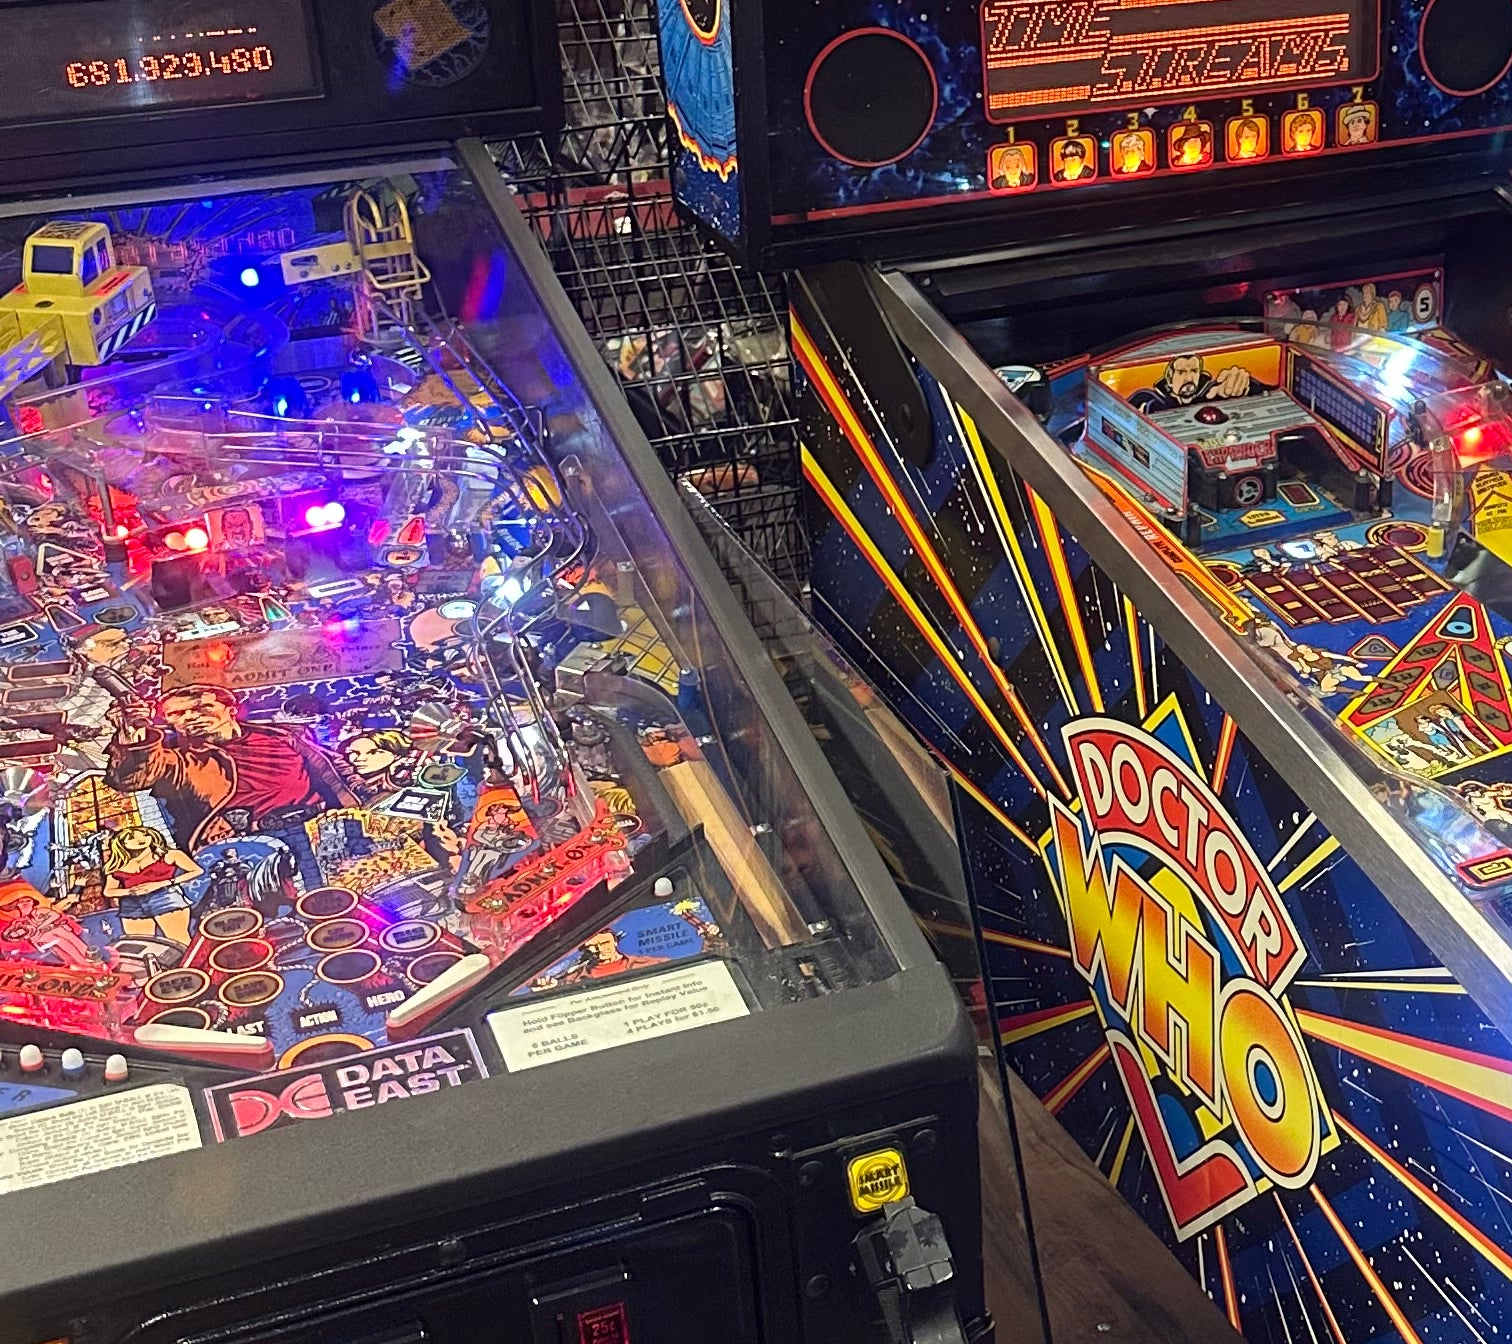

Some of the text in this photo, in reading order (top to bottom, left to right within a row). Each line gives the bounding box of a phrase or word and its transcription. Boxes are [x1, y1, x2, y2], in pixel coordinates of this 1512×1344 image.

[1092, 30, 1350, 96] STREAMS
[1296, 93, 1309, 110] 6
[1352, 86, 1365, 103] 7
[1182, 106, 1197, 121] 4
[1241, 99, 1254, 115] 5
[1065, 120, 1080, 136] 2
[1126, 112, 1140, 130] 3
[1006, 126, 1017, 144] 1
[1077, 742, 1285, 976] DOCTOR
[637, 922, 683, 939] SMART
[638, 929, 690, 948] MISSILE
[157, 976, 193, 988] RED
[1048, 789, 1322, 1190] WHO
[366, 989, 407, 1009] HERO
[299, 1008, 339, 1028] ACTION
[522, 1014, 549, 1028] Hold
[632, 1012, 664, 1026] PLAY
[227, 1020, 265, 1036] LAST
[540, 1033, 580, 1049] BALLS
[336, 1047, 457, 1090] DATA
[344, 1068, 467, 1112] EAST
[859, 1163, 900, 1185] SMART
[858, 1174, 902, 1198] MISSILE
